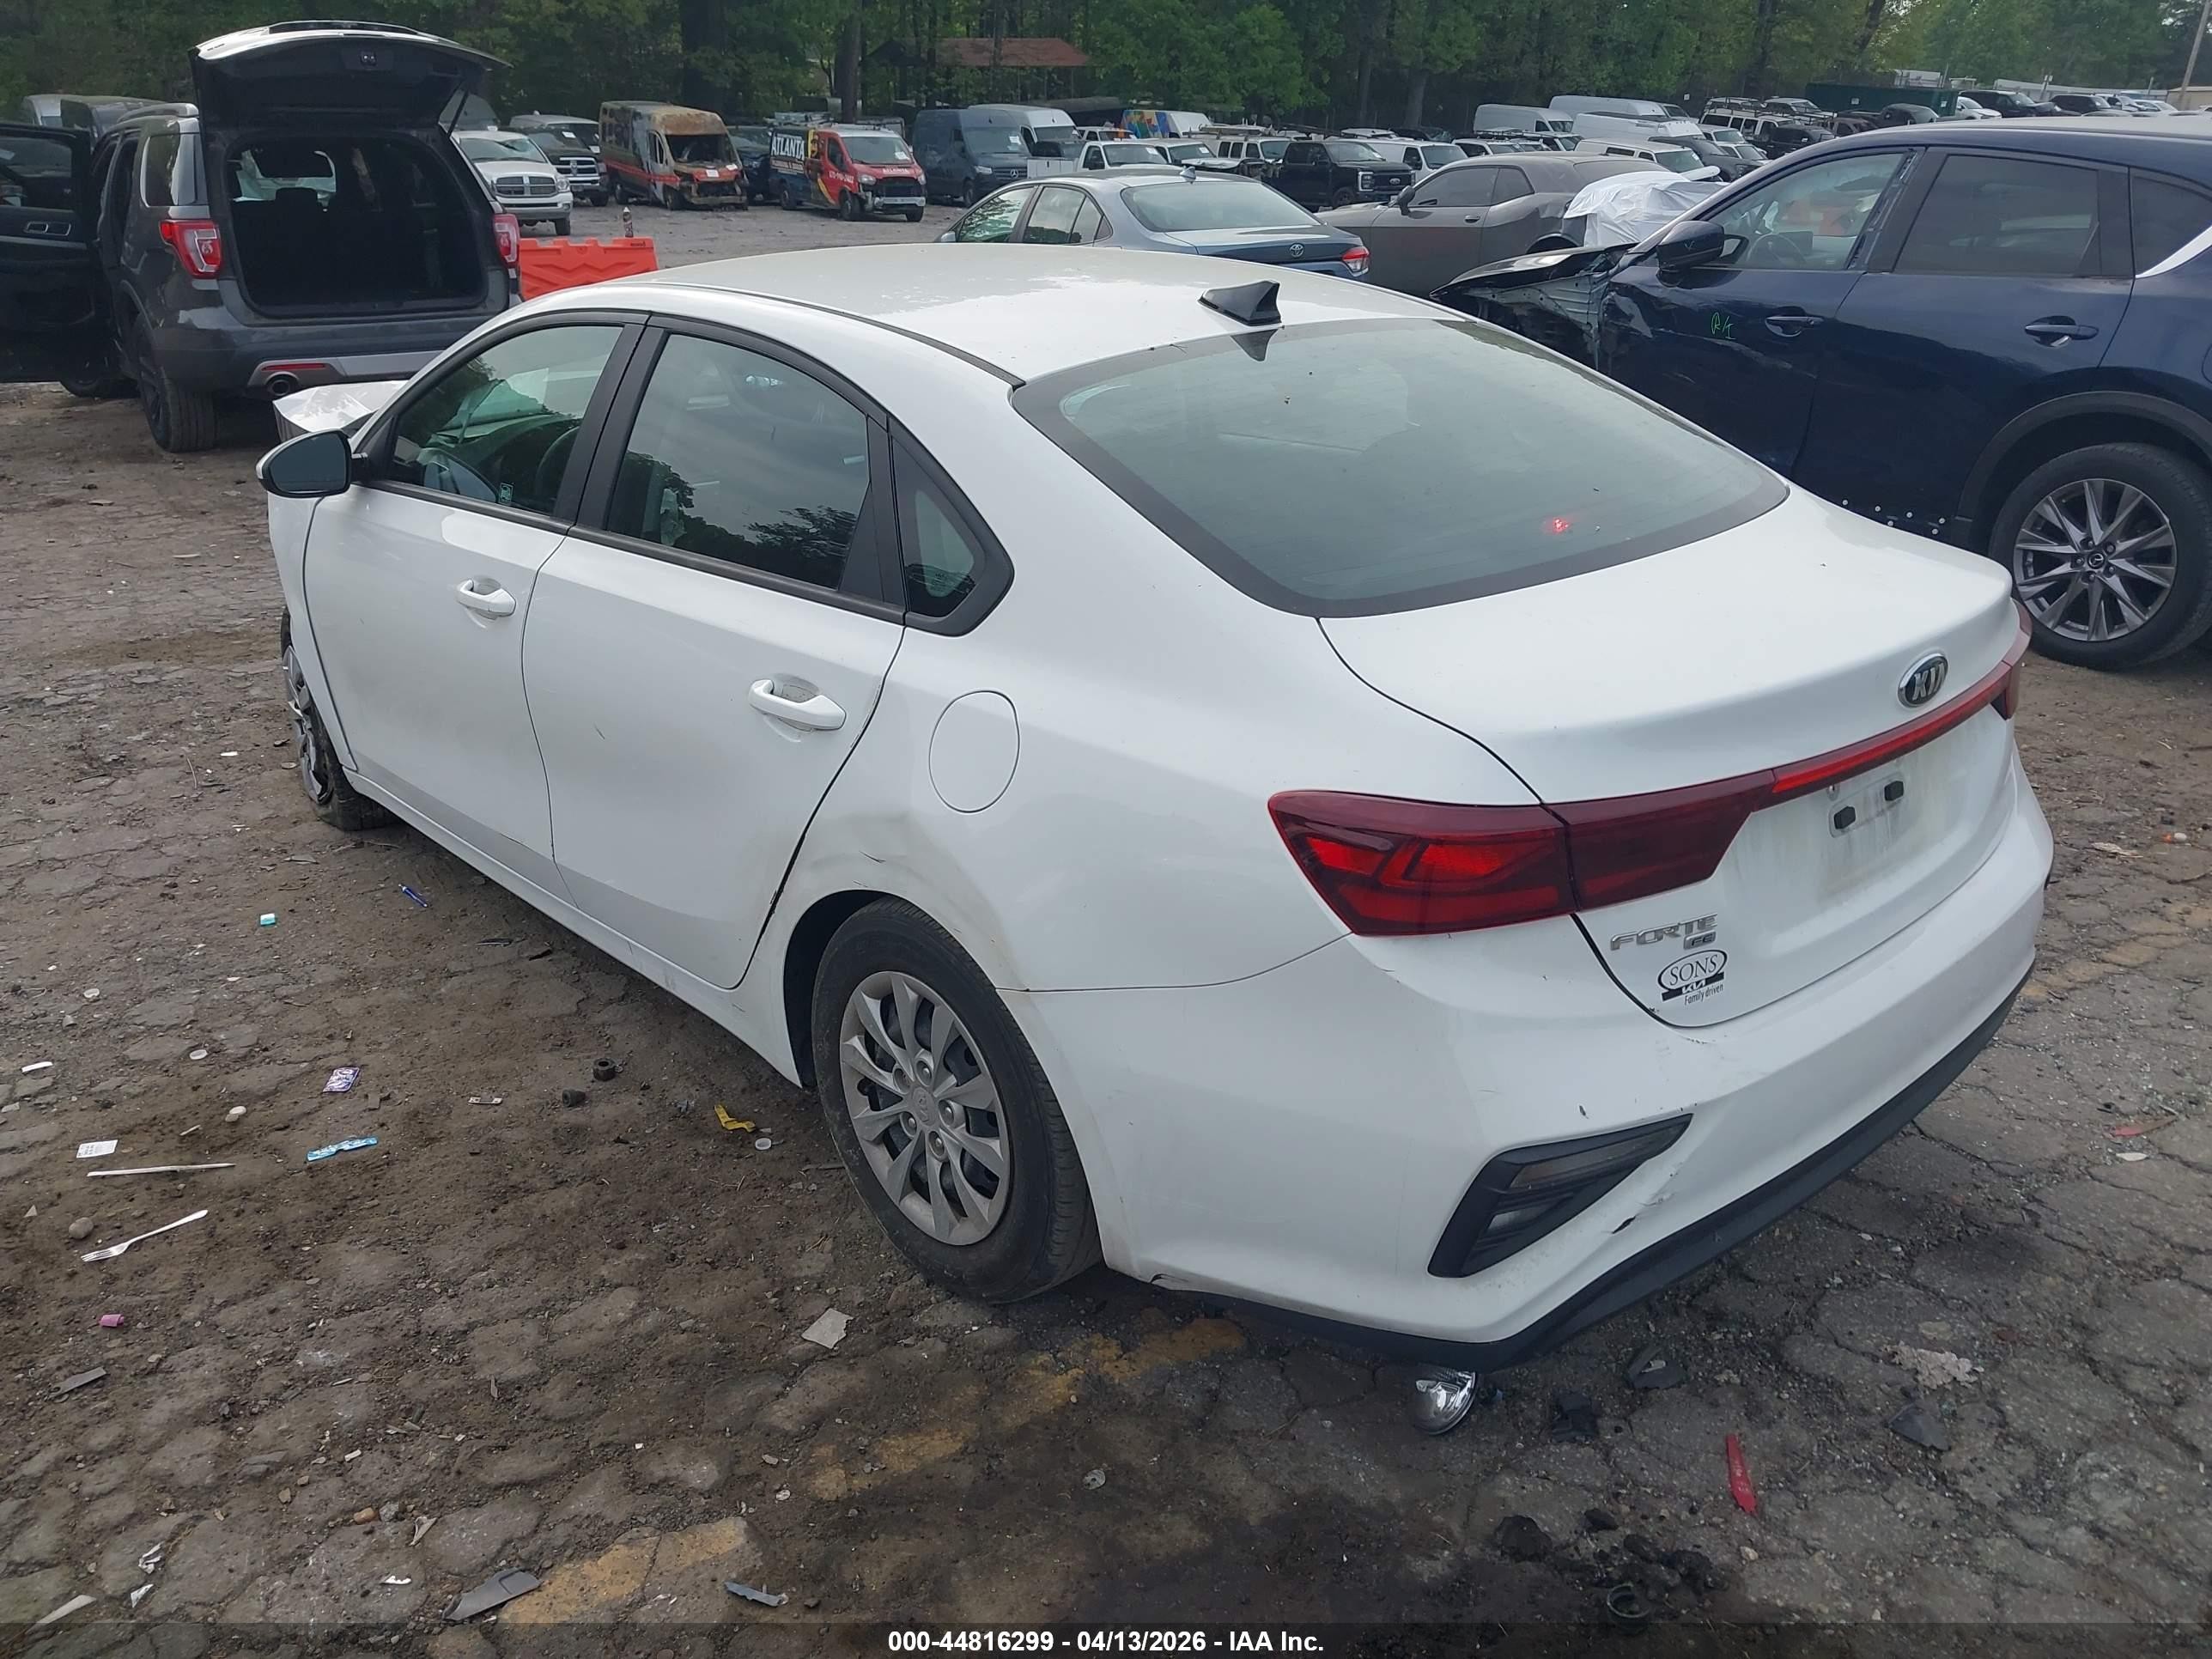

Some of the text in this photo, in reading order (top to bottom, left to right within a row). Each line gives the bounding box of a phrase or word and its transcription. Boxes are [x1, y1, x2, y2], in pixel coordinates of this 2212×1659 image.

[771, 136, 805, 161] ATLANTA
[1912, 662, 1945, 701] KIA
[1610, 913, 1718, 951] FORTE
[1690, 932, 1714, 946] FE
[1669, 953, 1718, 987] SONS
[1684, 983, 1724, 1006] Family driven
